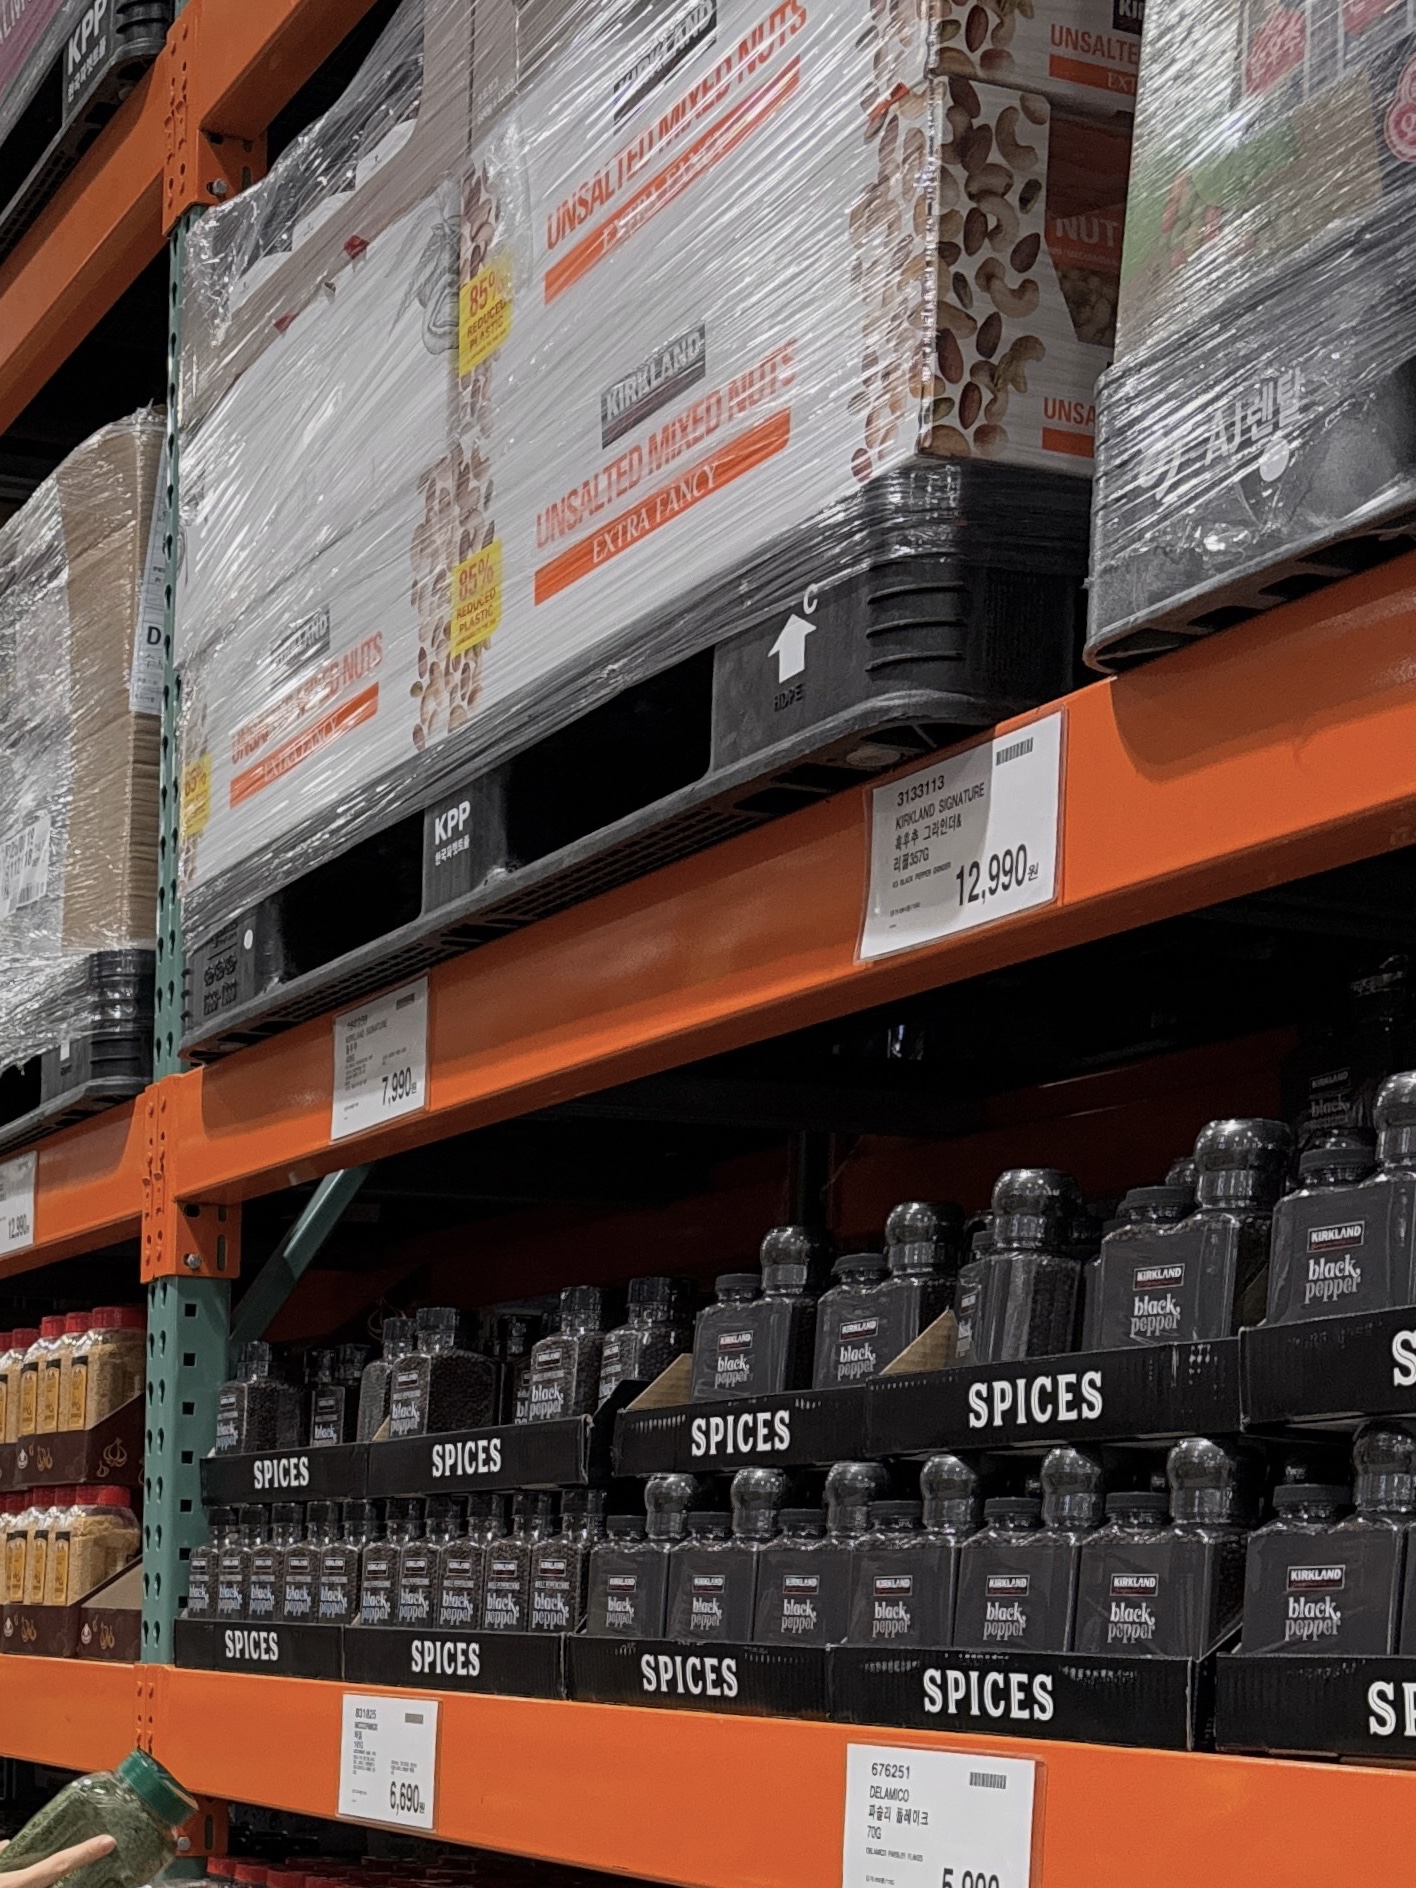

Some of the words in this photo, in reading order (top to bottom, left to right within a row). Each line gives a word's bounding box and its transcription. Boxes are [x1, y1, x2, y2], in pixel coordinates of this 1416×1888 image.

[66, 0, 108, 74] KPP
[737, 0, 807, 83] NUTS
[605, 331, 704, 421] KIRKLAND
[535, 444, 644, 548] UNSALTED
[648, 390, 723, 476] MIXED
[728, 336, 800, 421] NUTS
[592, 507, 651, 564] EXTRA
[656, 463, 717, 522] FANCY
[456, 587, 496, 620] REDUCED
[459, 604, 495, 635] PLASTIC
[897, 775, 945, 808] 3133113
[895, 804, 936, 831] KIRKLAND
[938, 781, 986, 814] SIGNATURE
[434, 801, 471, 846] KPP
[956, 843, 1040, 907] 12,990원
[1309, 1225, 1362, 1246] KIRKLAND
[1135, 1266, 1182, 1283] KIRKLAND
[1307, 1254, 1361, 1281] black
[1304, 1275, 1361, 1303] pepper
[1133, 1293, 1181, 1317] black
[1130, 1313, 1181, 1338] pepper
[717, 1354, 750, 1373] black
[838, 1342, 877, 1362] black
[968, 1370, 1104, 1429] SPICES
[691, 1409, 791, 1457] SPICES
[432, 1437, 503, 1479] SPICES
[253, 1456, 310, 1489] SPICES
[1290, 1569, 1343, 1582] KIRKLAND
[783, 1599, 817, 1619] black
[873, 1600, 911, 1622] black
[985, 1601, 1027, 1623] black
[1110, 1602, 1156, 1625] black
[1287, 1596, 1342, 1620] black
[872, 1616, 911, 1639] pepper
[983, 1618, 1027, 1640] pepper
[1107, 1620, 1156, 1644] pepper
[1285, 1615, 1342, 1641] pepper
[225, 1629, 280, 1662] SPICES
[410, 1640, 481, 1678] SPICES
[641, 1653, 739, 1698] SPICES
[923, 1667, 1055, 1722] SPICES
[871, 1762, 911, 1780] 676251
[869, 1785, 910, 1803] DELAMICO
[868, 1804, 892, 1823] 파슬리
[896, 1807, 930, 1827] 플레이크
[867, 1825, 882, 1840] 70G
